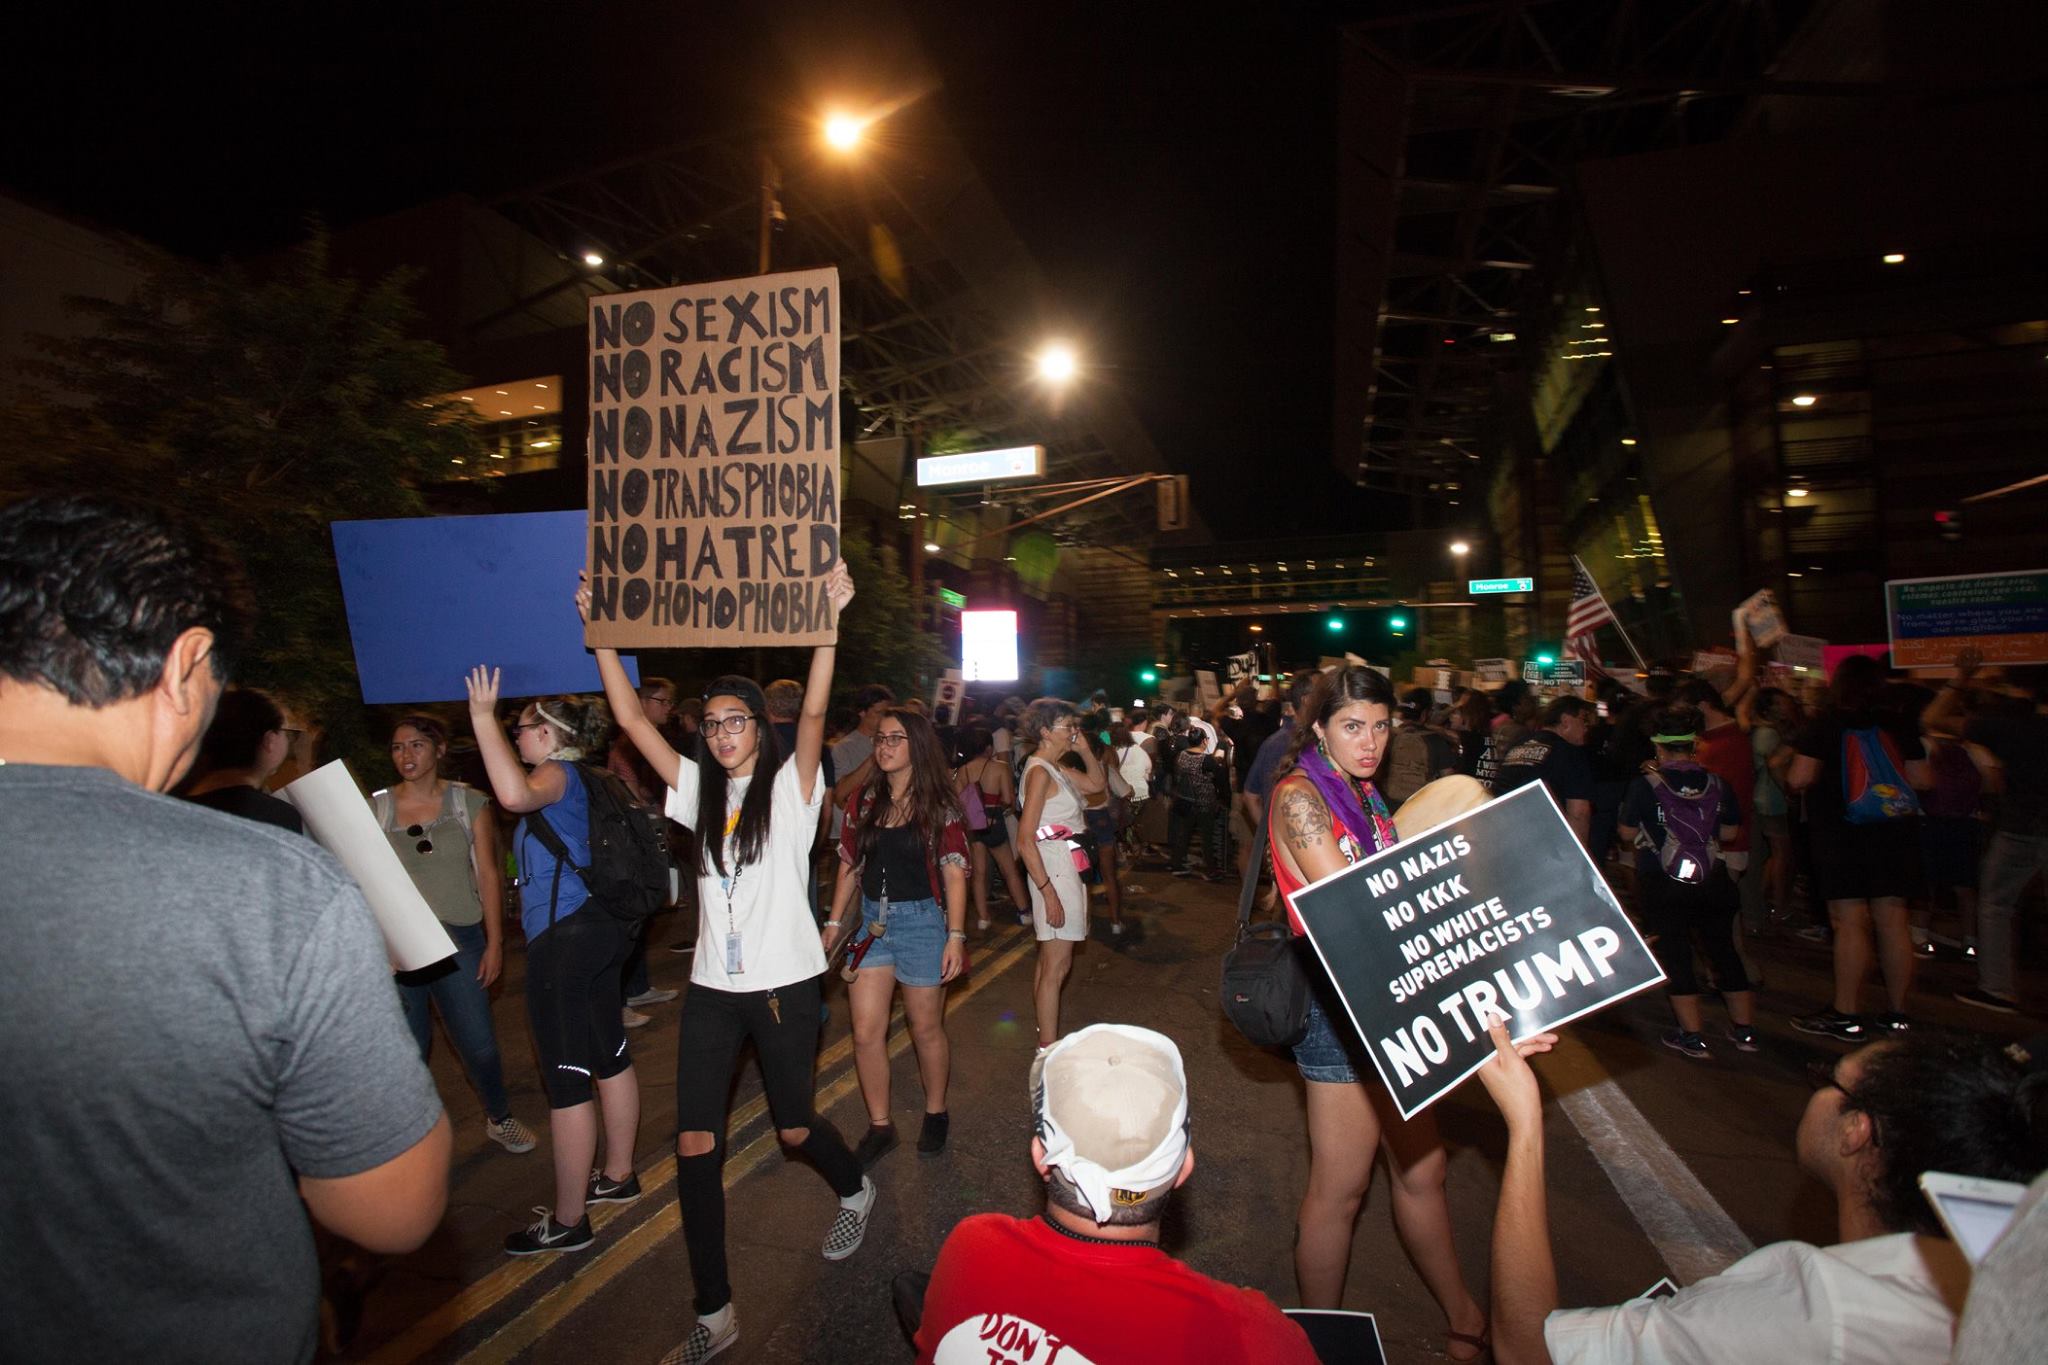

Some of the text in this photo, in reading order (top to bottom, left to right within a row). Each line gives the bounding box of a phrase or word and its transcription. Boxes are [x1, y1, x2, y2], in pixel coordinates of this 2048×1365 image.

[594, 287, 830, 349] NO SEXISM
[594, 337, 828, 402] NO RACISM
[594, 394, 833, 463] NO NAZISM
[594, 462, 837, 523] NO TRANSPHOBIA
[593, 524, 838, 580] NO HATRED
[591, 577, 833, 633] NO HOMOPHOBIA
[1365, 834, 1472, 899] NO NAZIS
[1382, 874, 1470, 931] NO KKK
[1399, 896, 1508, 964] NO WHITE
[1388, 905, 1552, 1004] SUPREMACISTS
[1380, 925, 1621, 1089] NO TRUMP
[979, 1313, 1062, 1365] DON'T
